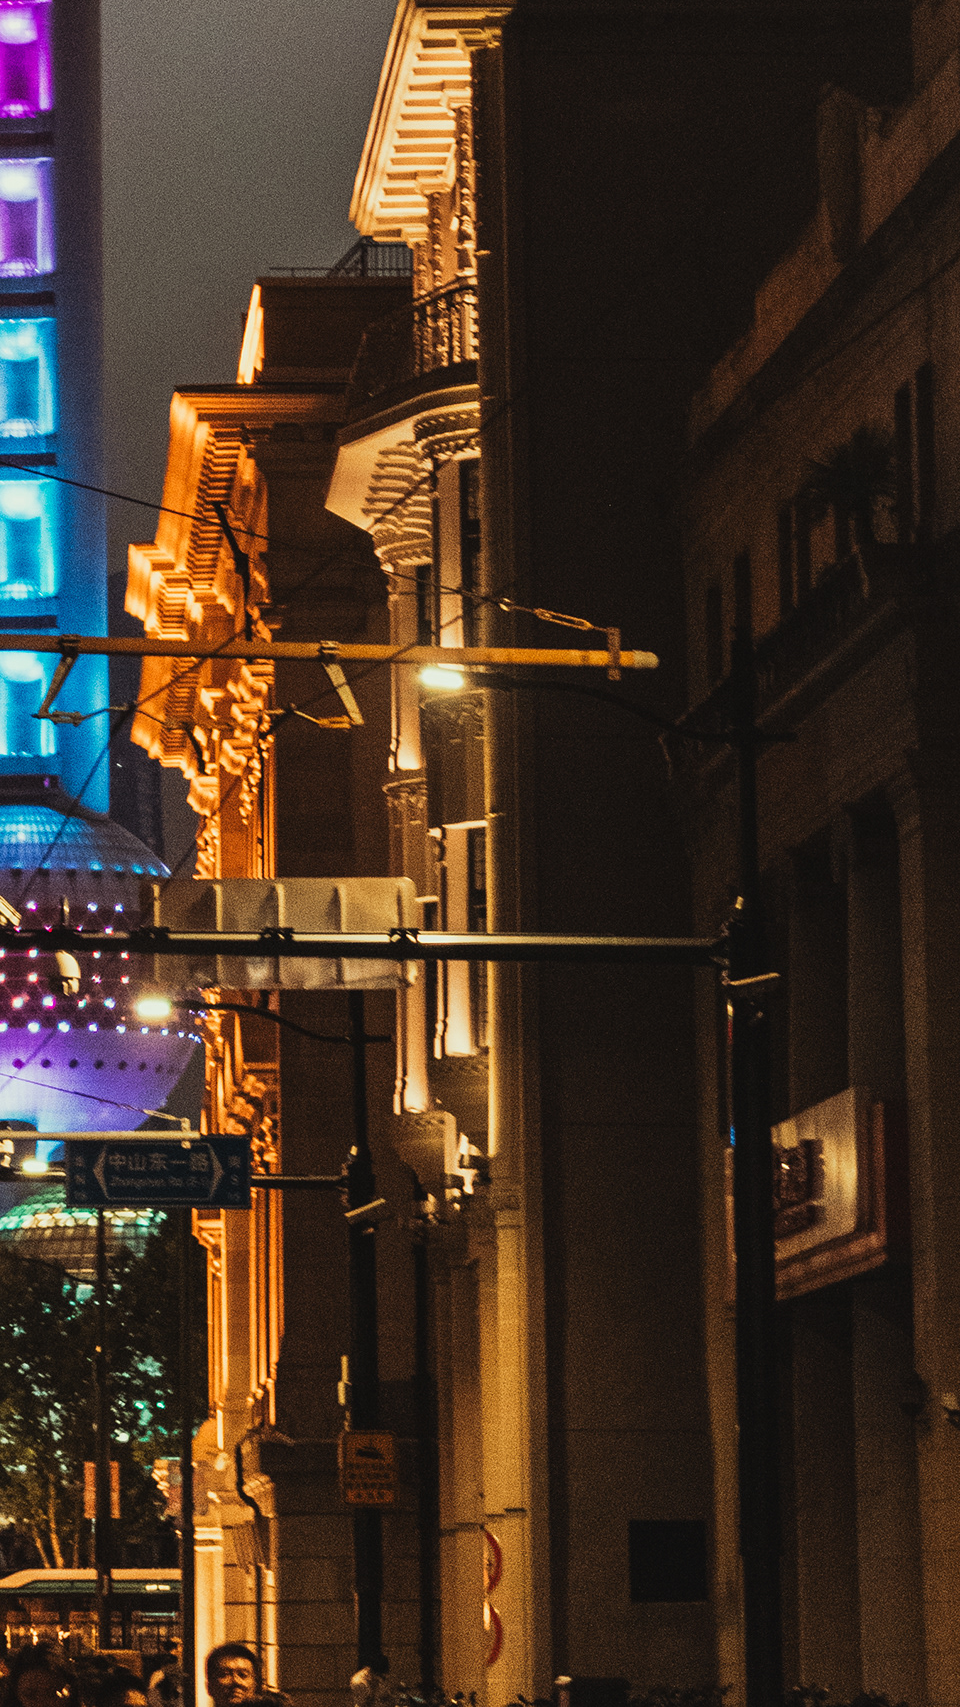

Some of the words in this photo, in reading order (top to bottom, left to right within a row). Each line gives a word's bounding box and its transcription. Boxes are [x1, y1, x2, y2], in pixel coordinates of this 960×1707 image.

[108, 1152, 209, 1172] 中山东一路
